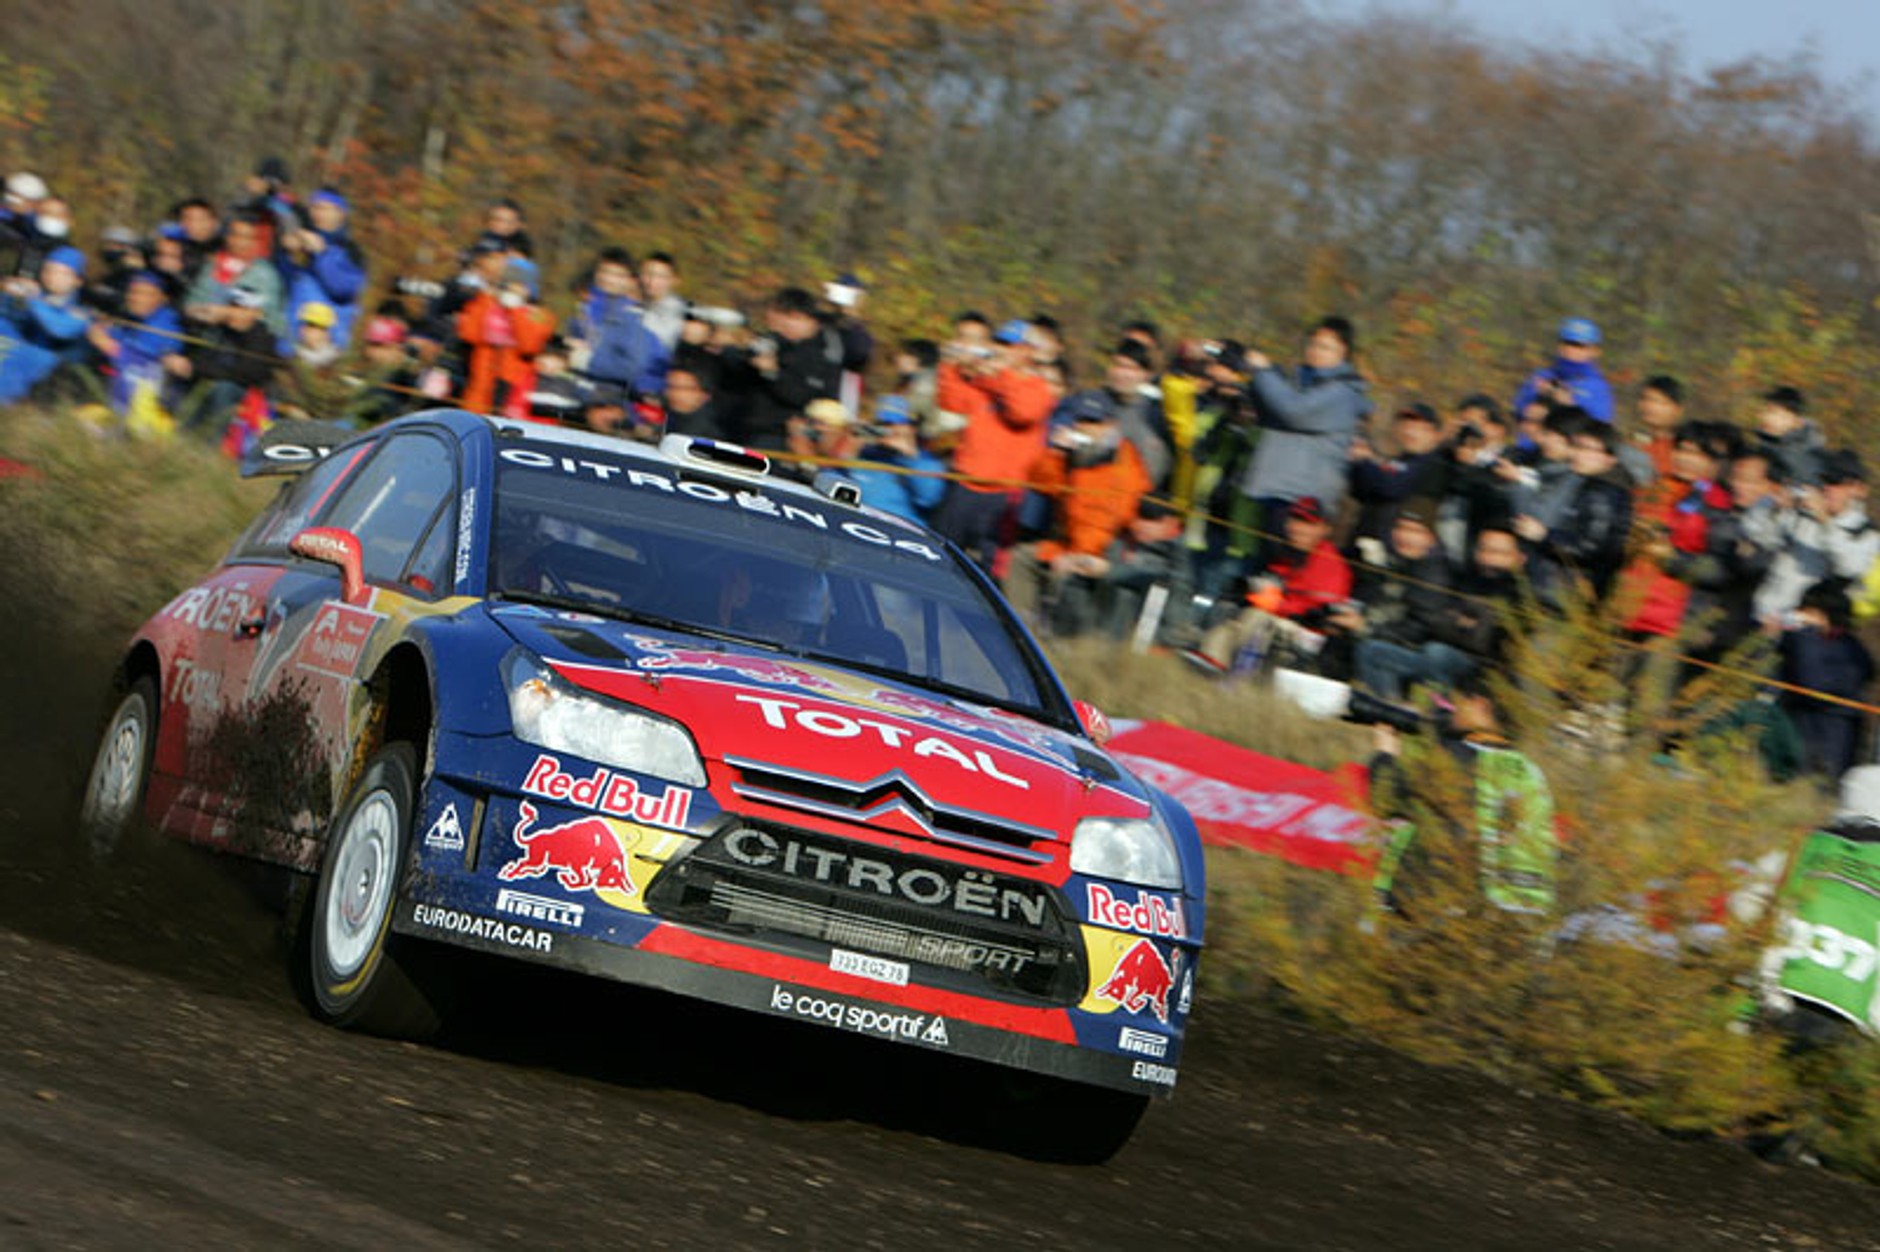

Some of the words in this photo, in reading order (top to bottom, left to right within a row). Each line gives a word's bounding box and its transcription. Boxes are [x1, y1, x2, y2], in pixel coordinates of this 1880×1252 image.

[500, 448, 828, 530] CITROËN
[841, 522, 942, 562] C4
[735, 694, 1030, 789] TOTAL
[521, 754, 605, 809] Red
[599, 774, 692, 828] Bull
[724, 828, 1048, 926] CITROËN
[413, 904, 552, 953] EURODATACAR
[496, 888, 585, 927] PIRELLI
[1087, 882, 1151, 934] Red
[917, 935, 1036, 974] SPORT
[770, 984, 793, 1010] le
[797, 996, 845, 1028] coq
[846, 1006, 925, 1039] sportif
[1118, 1027, 1169, 1058] PIRELLI
